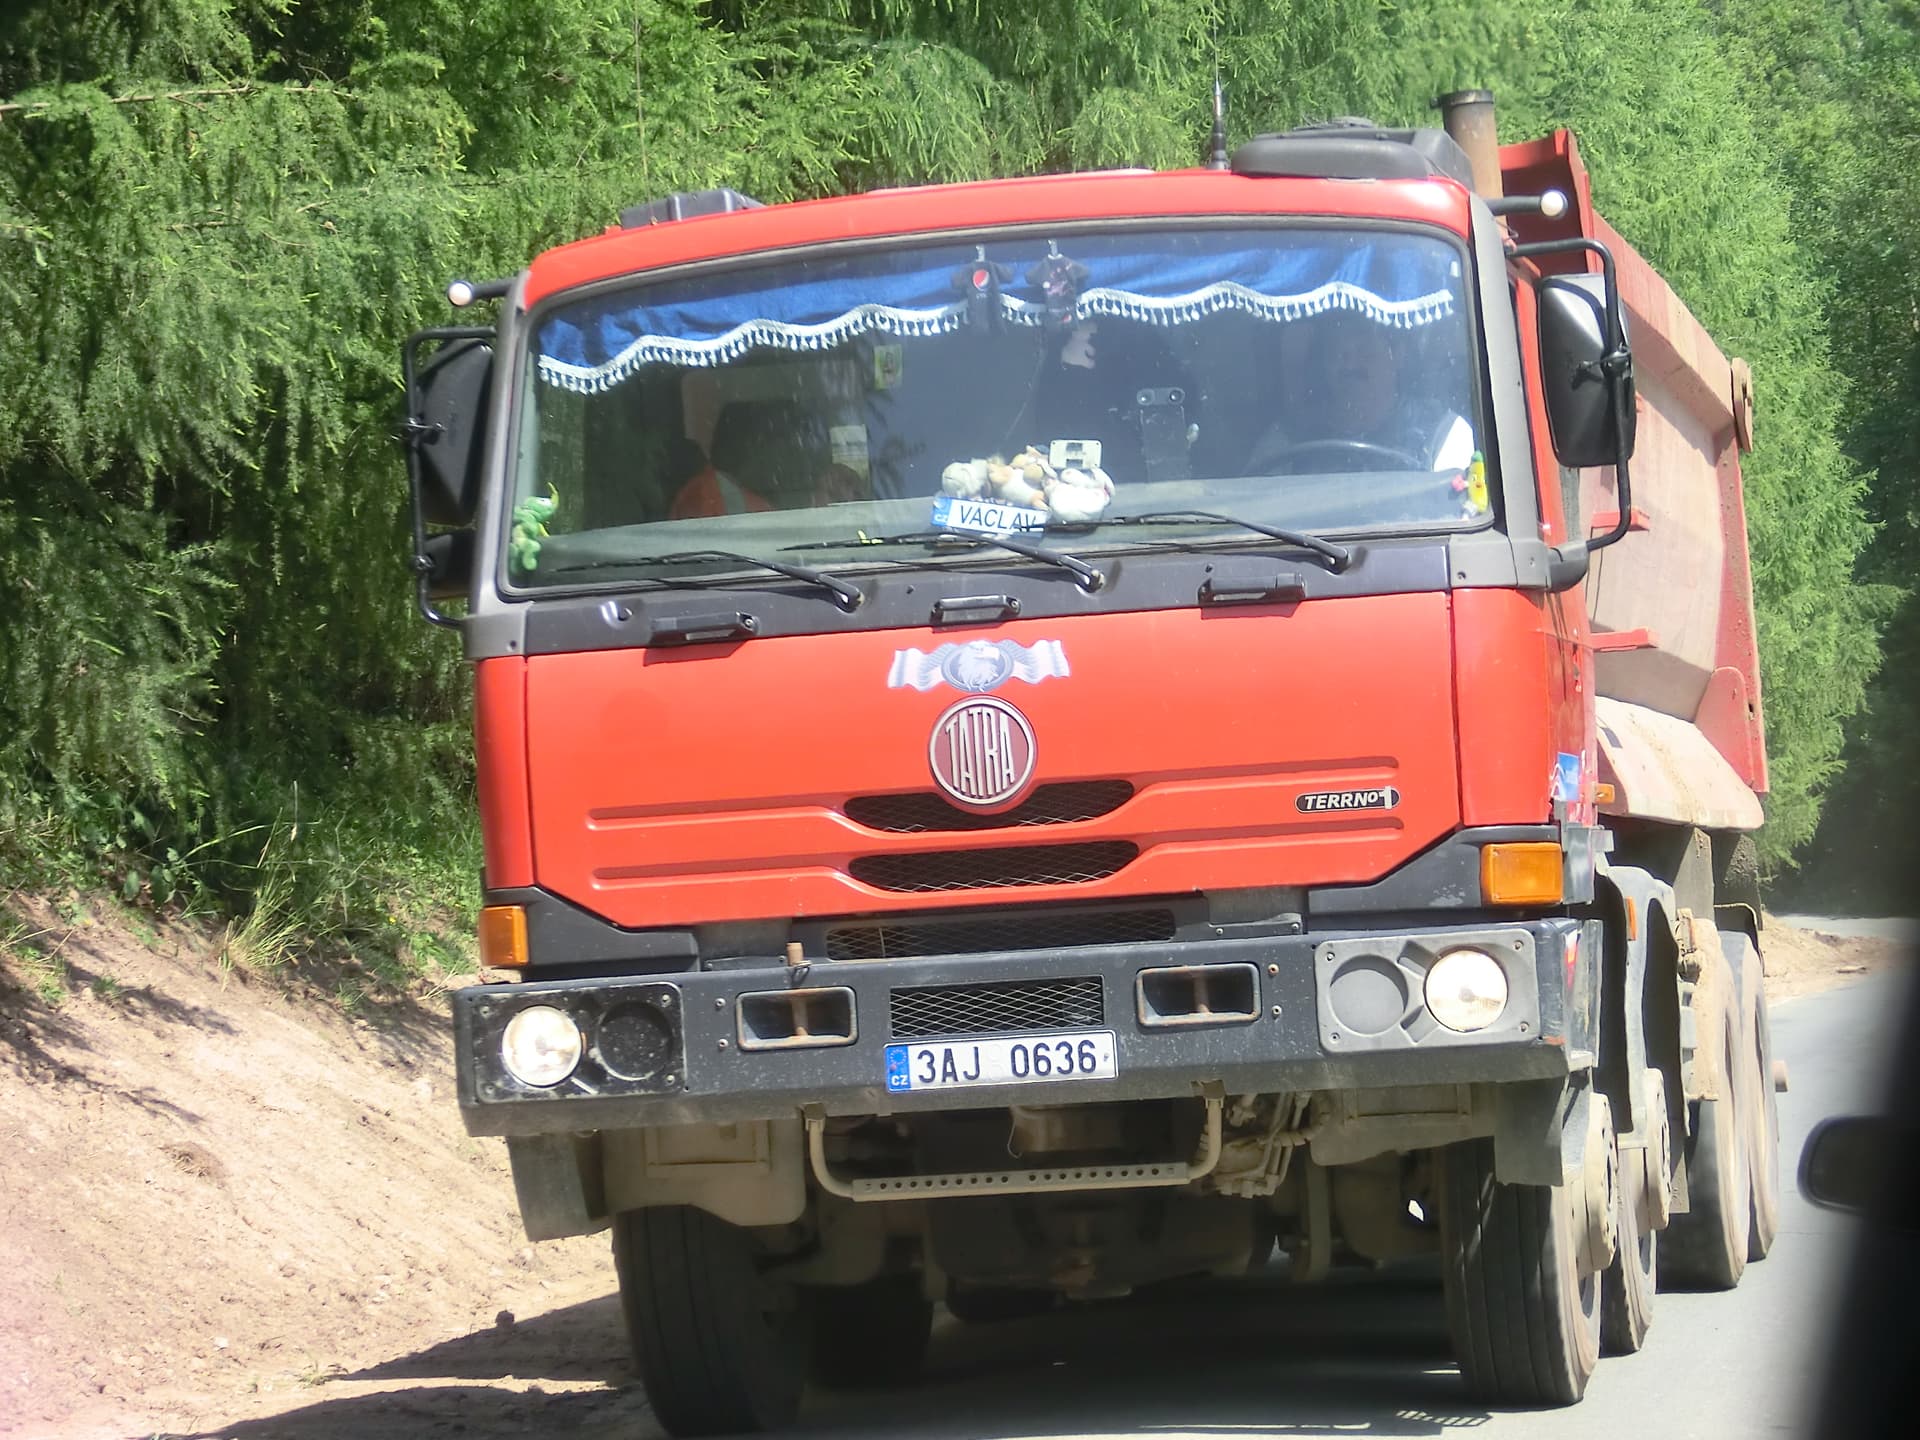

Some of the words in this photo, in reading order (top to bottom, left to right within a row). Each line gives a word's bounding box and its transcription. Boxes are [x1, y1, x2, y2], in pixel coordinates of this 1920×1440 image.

[960, 504, 1036, 531] VACLAV
[945, 706, 1015, 798] TATRA
[890, 1074, 908, 1086] CZ
[917, 1046, 981, 1083] 3AJ
[1010, 1039, 1097, 1078] 0636
